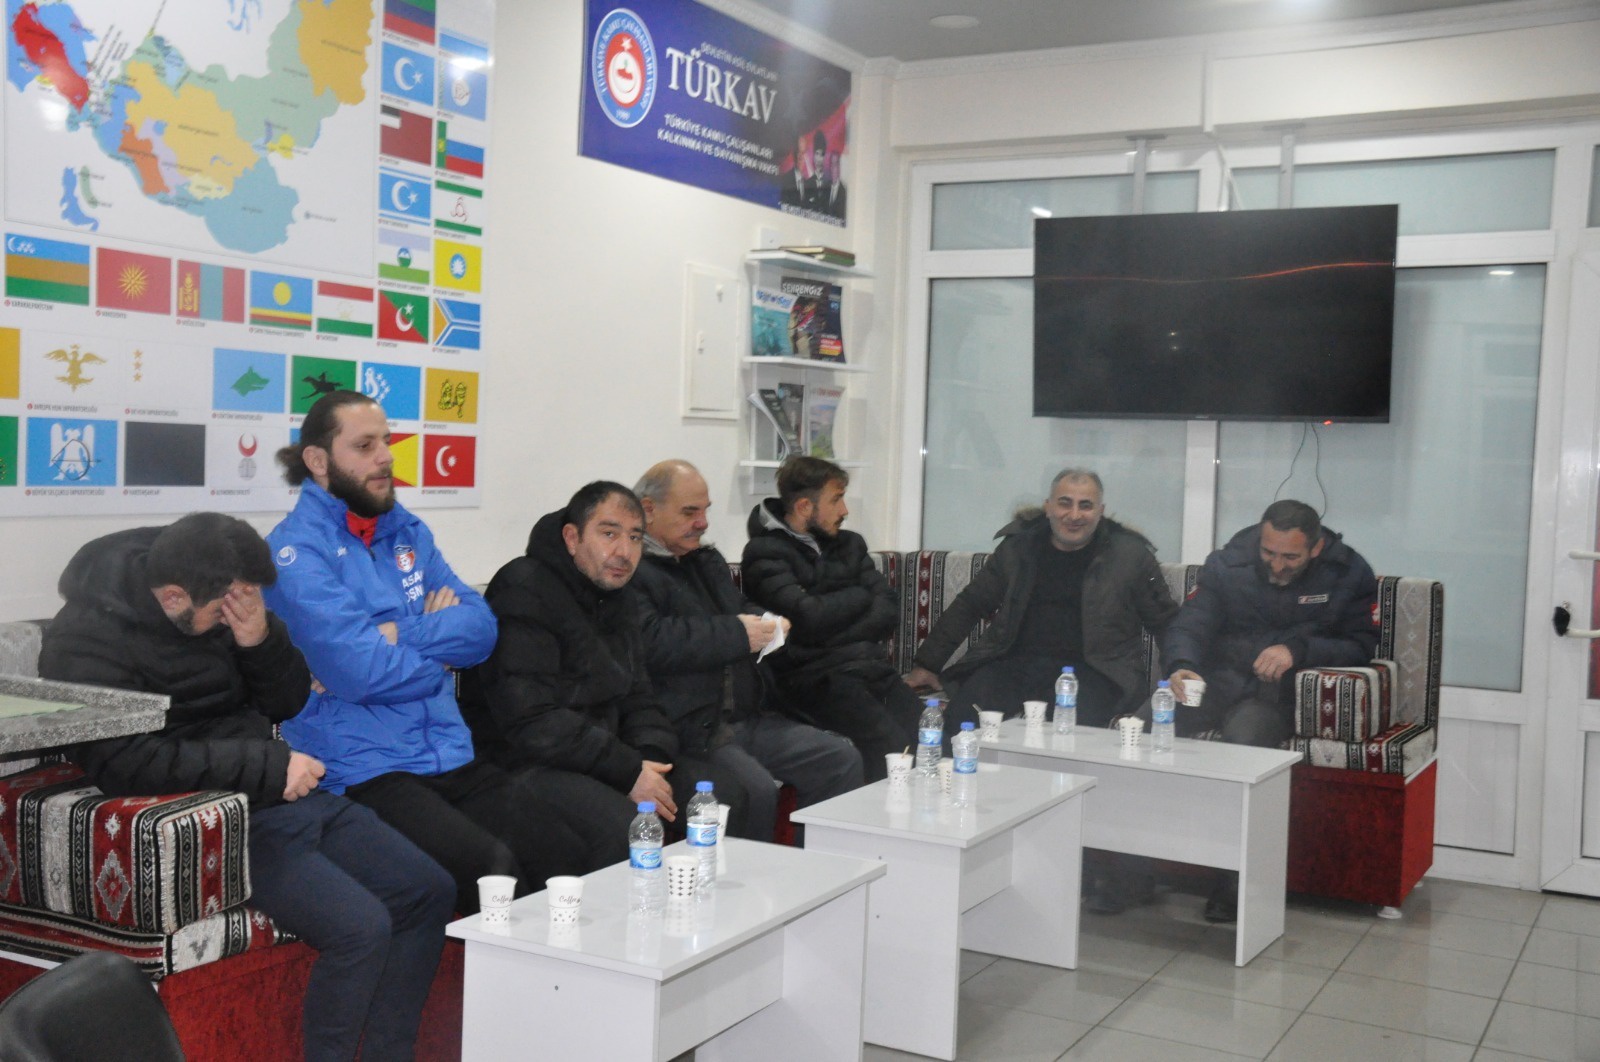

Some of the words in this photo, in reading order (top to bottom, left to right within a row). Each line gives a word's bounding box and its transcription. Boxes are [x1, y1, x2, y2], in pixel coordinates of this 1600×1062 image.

[666, 46, 778, 124] TÜRKAV
[657, 128, 703, 152] KALKINMA
[702, 141, 714, 156] VE
[713, 146, 760, 169] DAYANIŞMA
[664, 113, 701, 136] TÜRKİYE
[701, 126, 727, 144] KAMU
[725, 134, 774, 160] ÇALIŞANLARI
